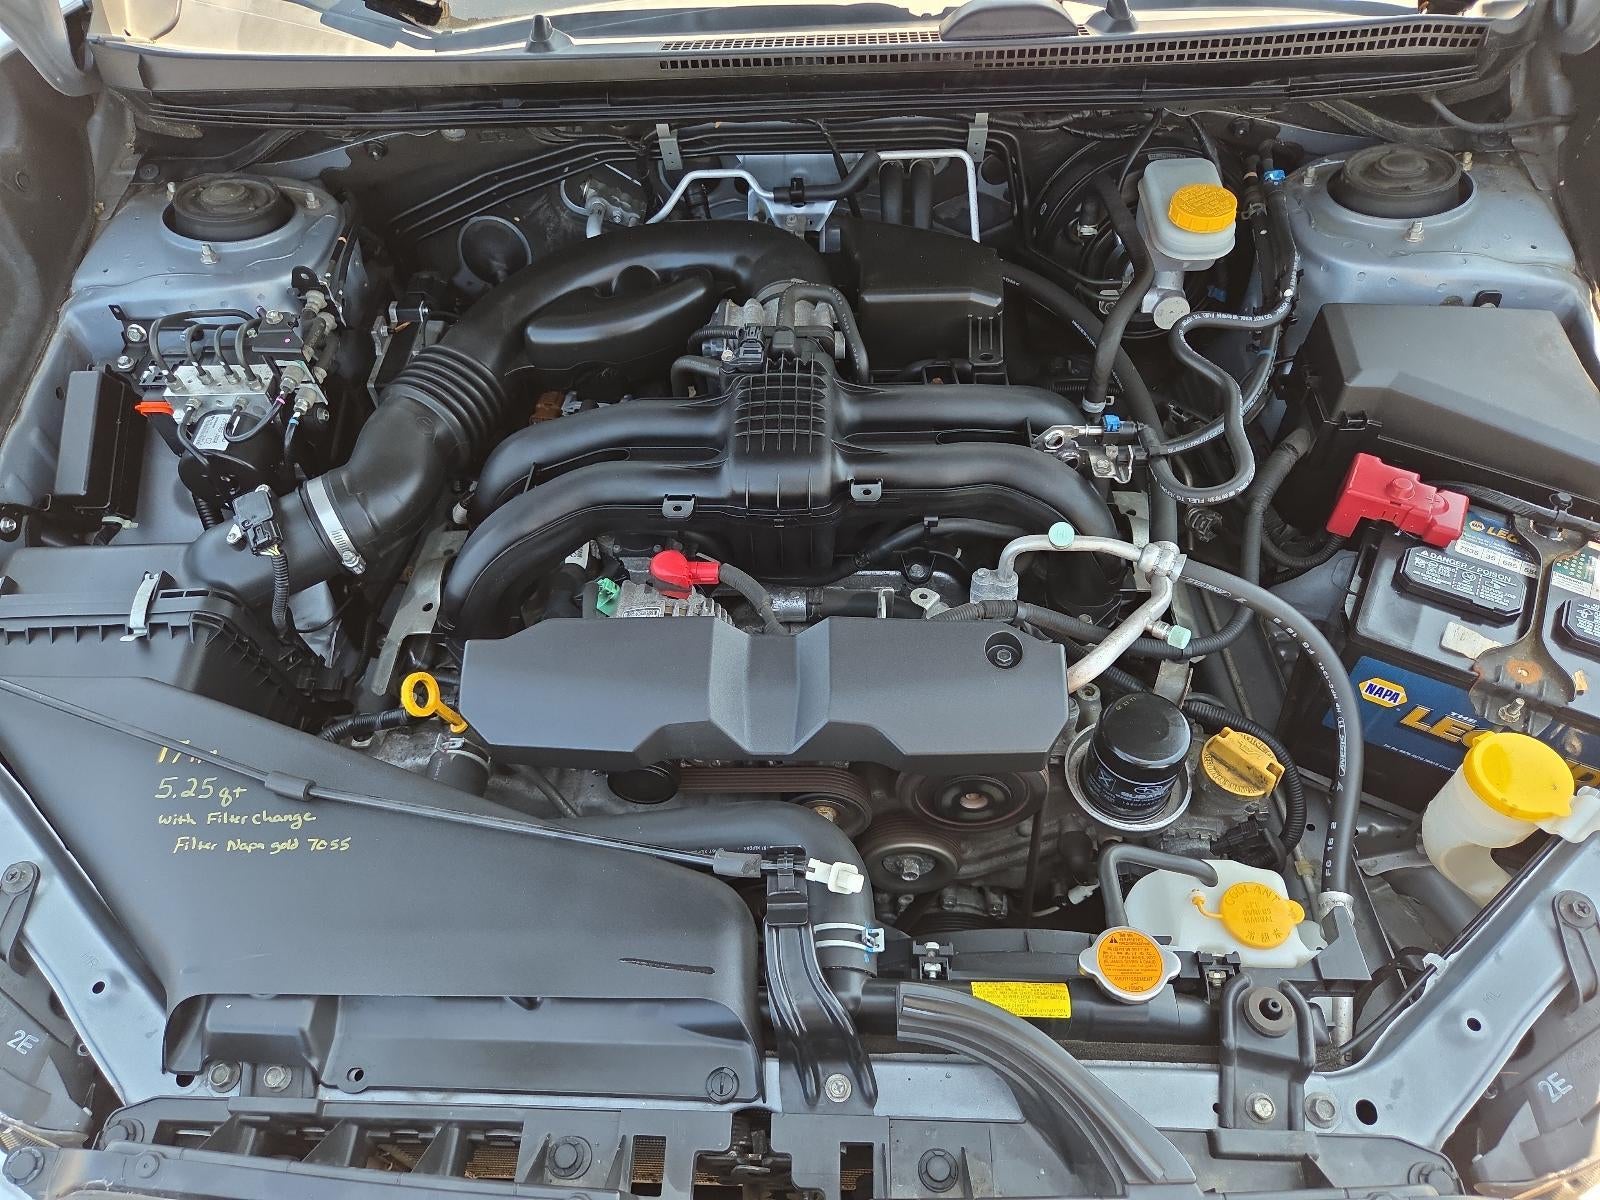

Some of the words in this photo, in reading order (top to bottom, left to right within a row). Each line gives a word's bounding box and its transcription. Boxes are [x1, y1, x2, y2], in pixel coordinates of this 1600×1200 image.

[1427, 552, 1467, 568] DANGER
[1477, 567, 1512, 582] POISON
[1364, 682, 1401, 704] NAPA
[154, 776, 218, 799] 5.25
[159, 813, 197, 825] with
[207, 811, 248, 825] Filter
[173, 836, 218, 854] Filter
[307, 837, 352, 851] 7055
[1324, 859, 1332, 877] FG
[1225, 885, 1281, 906] COOLANT
[6, 1029, 40, 1055] 2E
[1537, 1071, 1574, 1104] 2E
